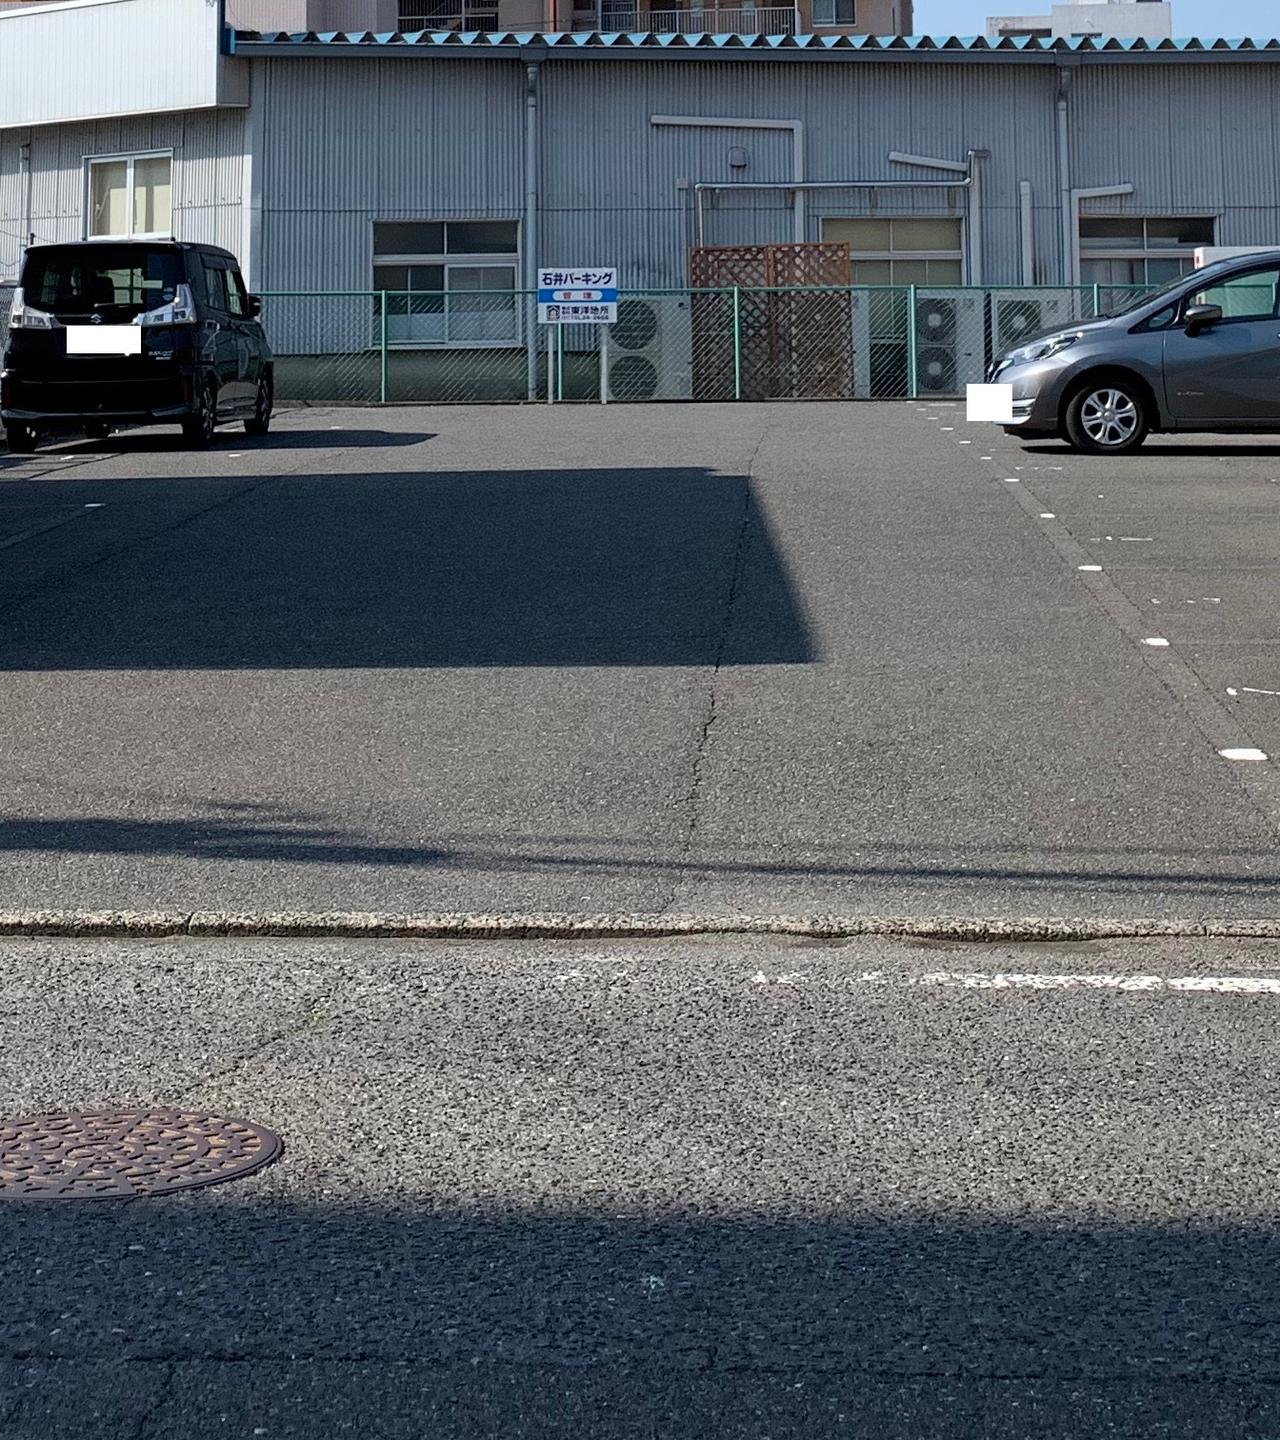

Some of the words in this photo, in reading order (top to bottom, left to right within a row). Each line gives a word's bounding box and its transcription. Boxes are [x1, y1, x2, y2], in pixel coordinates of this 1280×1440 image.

[542, 271, 613, 286] 石井パーキング
